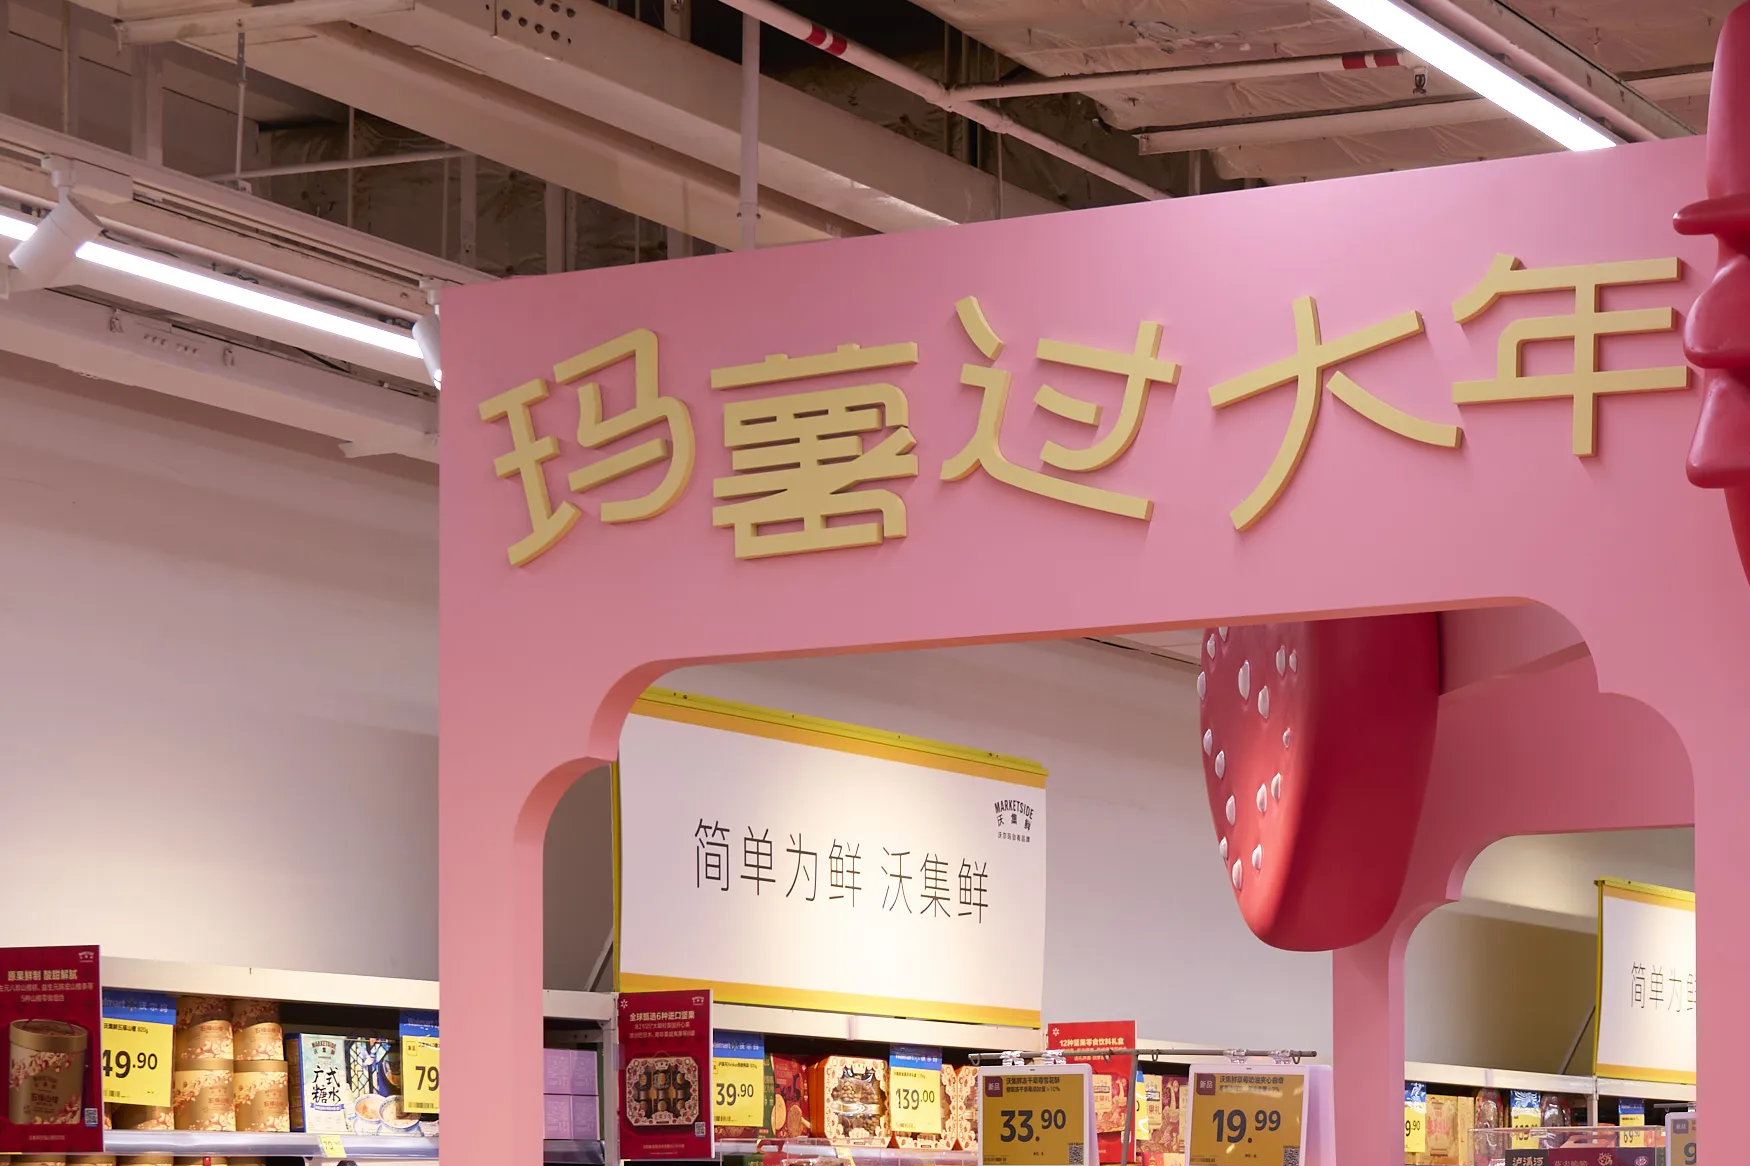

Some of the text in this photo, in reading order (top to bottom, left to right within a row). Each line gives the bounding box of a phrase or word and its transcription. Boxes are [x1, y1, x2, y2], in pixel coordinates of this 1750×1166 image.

[479, 252, 1691, 567] 玛薯过大年
[994, 799, 1034, 820] MARKETSIDE
[996, 814, 1032, 831] 沃集鲜
[694, 818, 990, 924] 简单为鲜 沃集鲜
[102, 1049, 158, 1079] 49.90
[313, 1065, 340, 1087] 广式
[988, 1082, 1000, 1091] 新品
[1200, 1081, 1213, 1089] 新品
[311, 1087, 341, 1105] 糖水
[716, 1083, 754, 1106] 39.90
[895, 1088, 935, 1111] 139.00
[1000, 1109, 1066, 1143] 33.90
[1212, 1109, 1281, 1144] 19.99
[1512, 1157, 1544, 1166] 泸溪河
